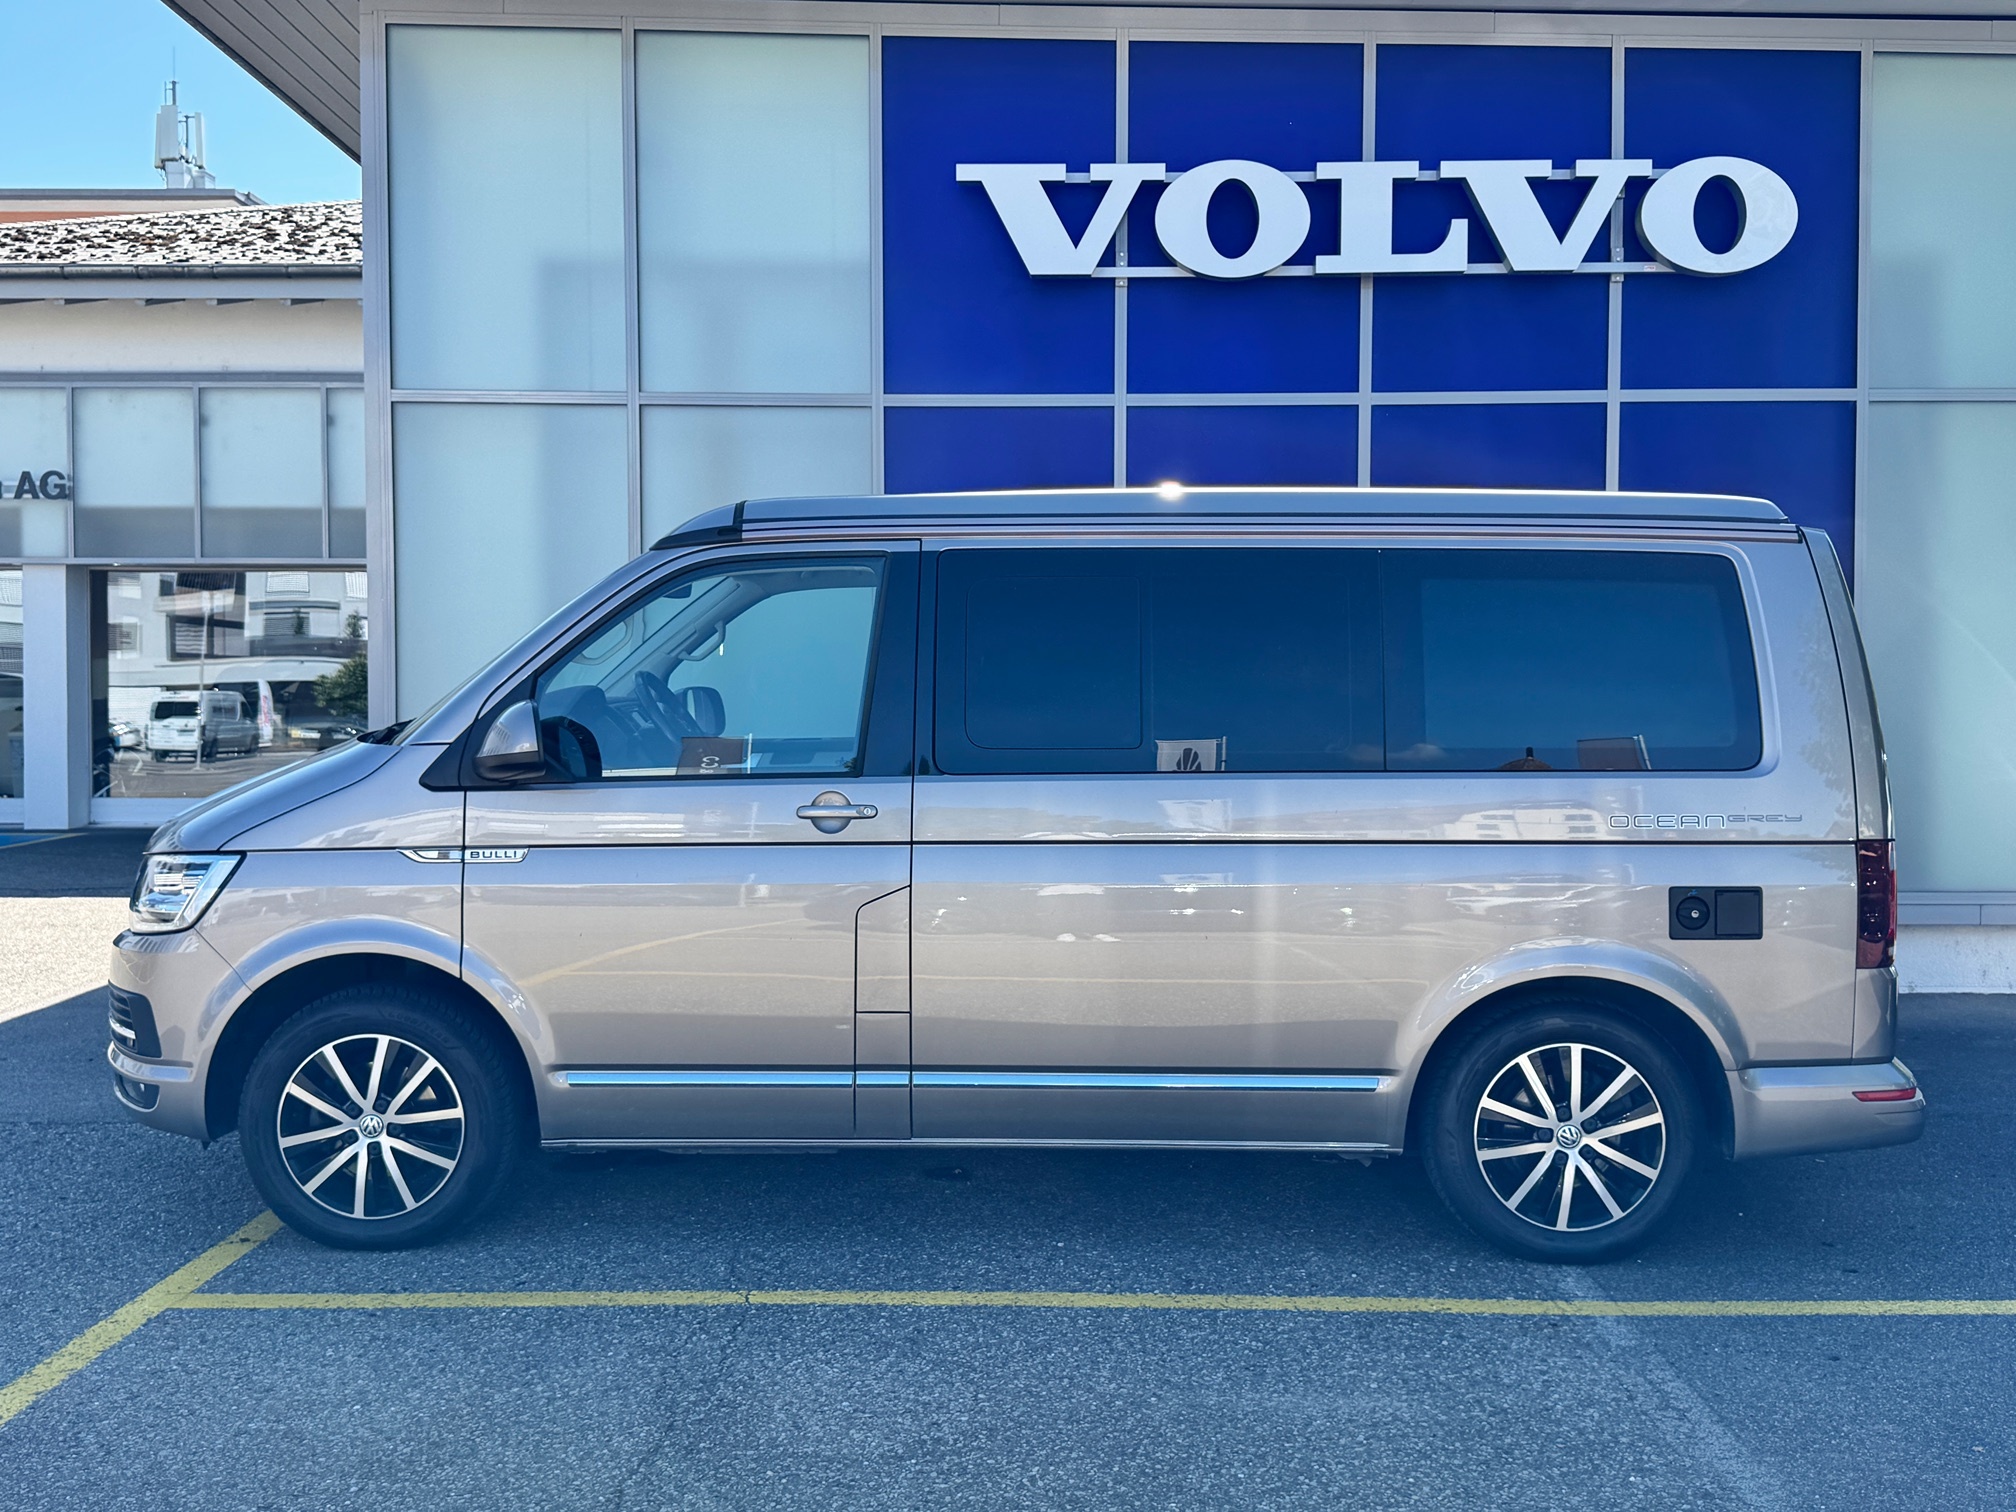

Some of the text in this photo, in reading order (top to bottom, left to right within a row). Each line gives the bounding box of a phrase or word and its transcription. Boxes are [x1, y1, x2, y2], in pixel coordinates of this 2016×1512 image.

[956, 156, 1799, 278] VOLVO
[13, 470, 68, 500] AG
[470, 850, 517, 859] BULLI
